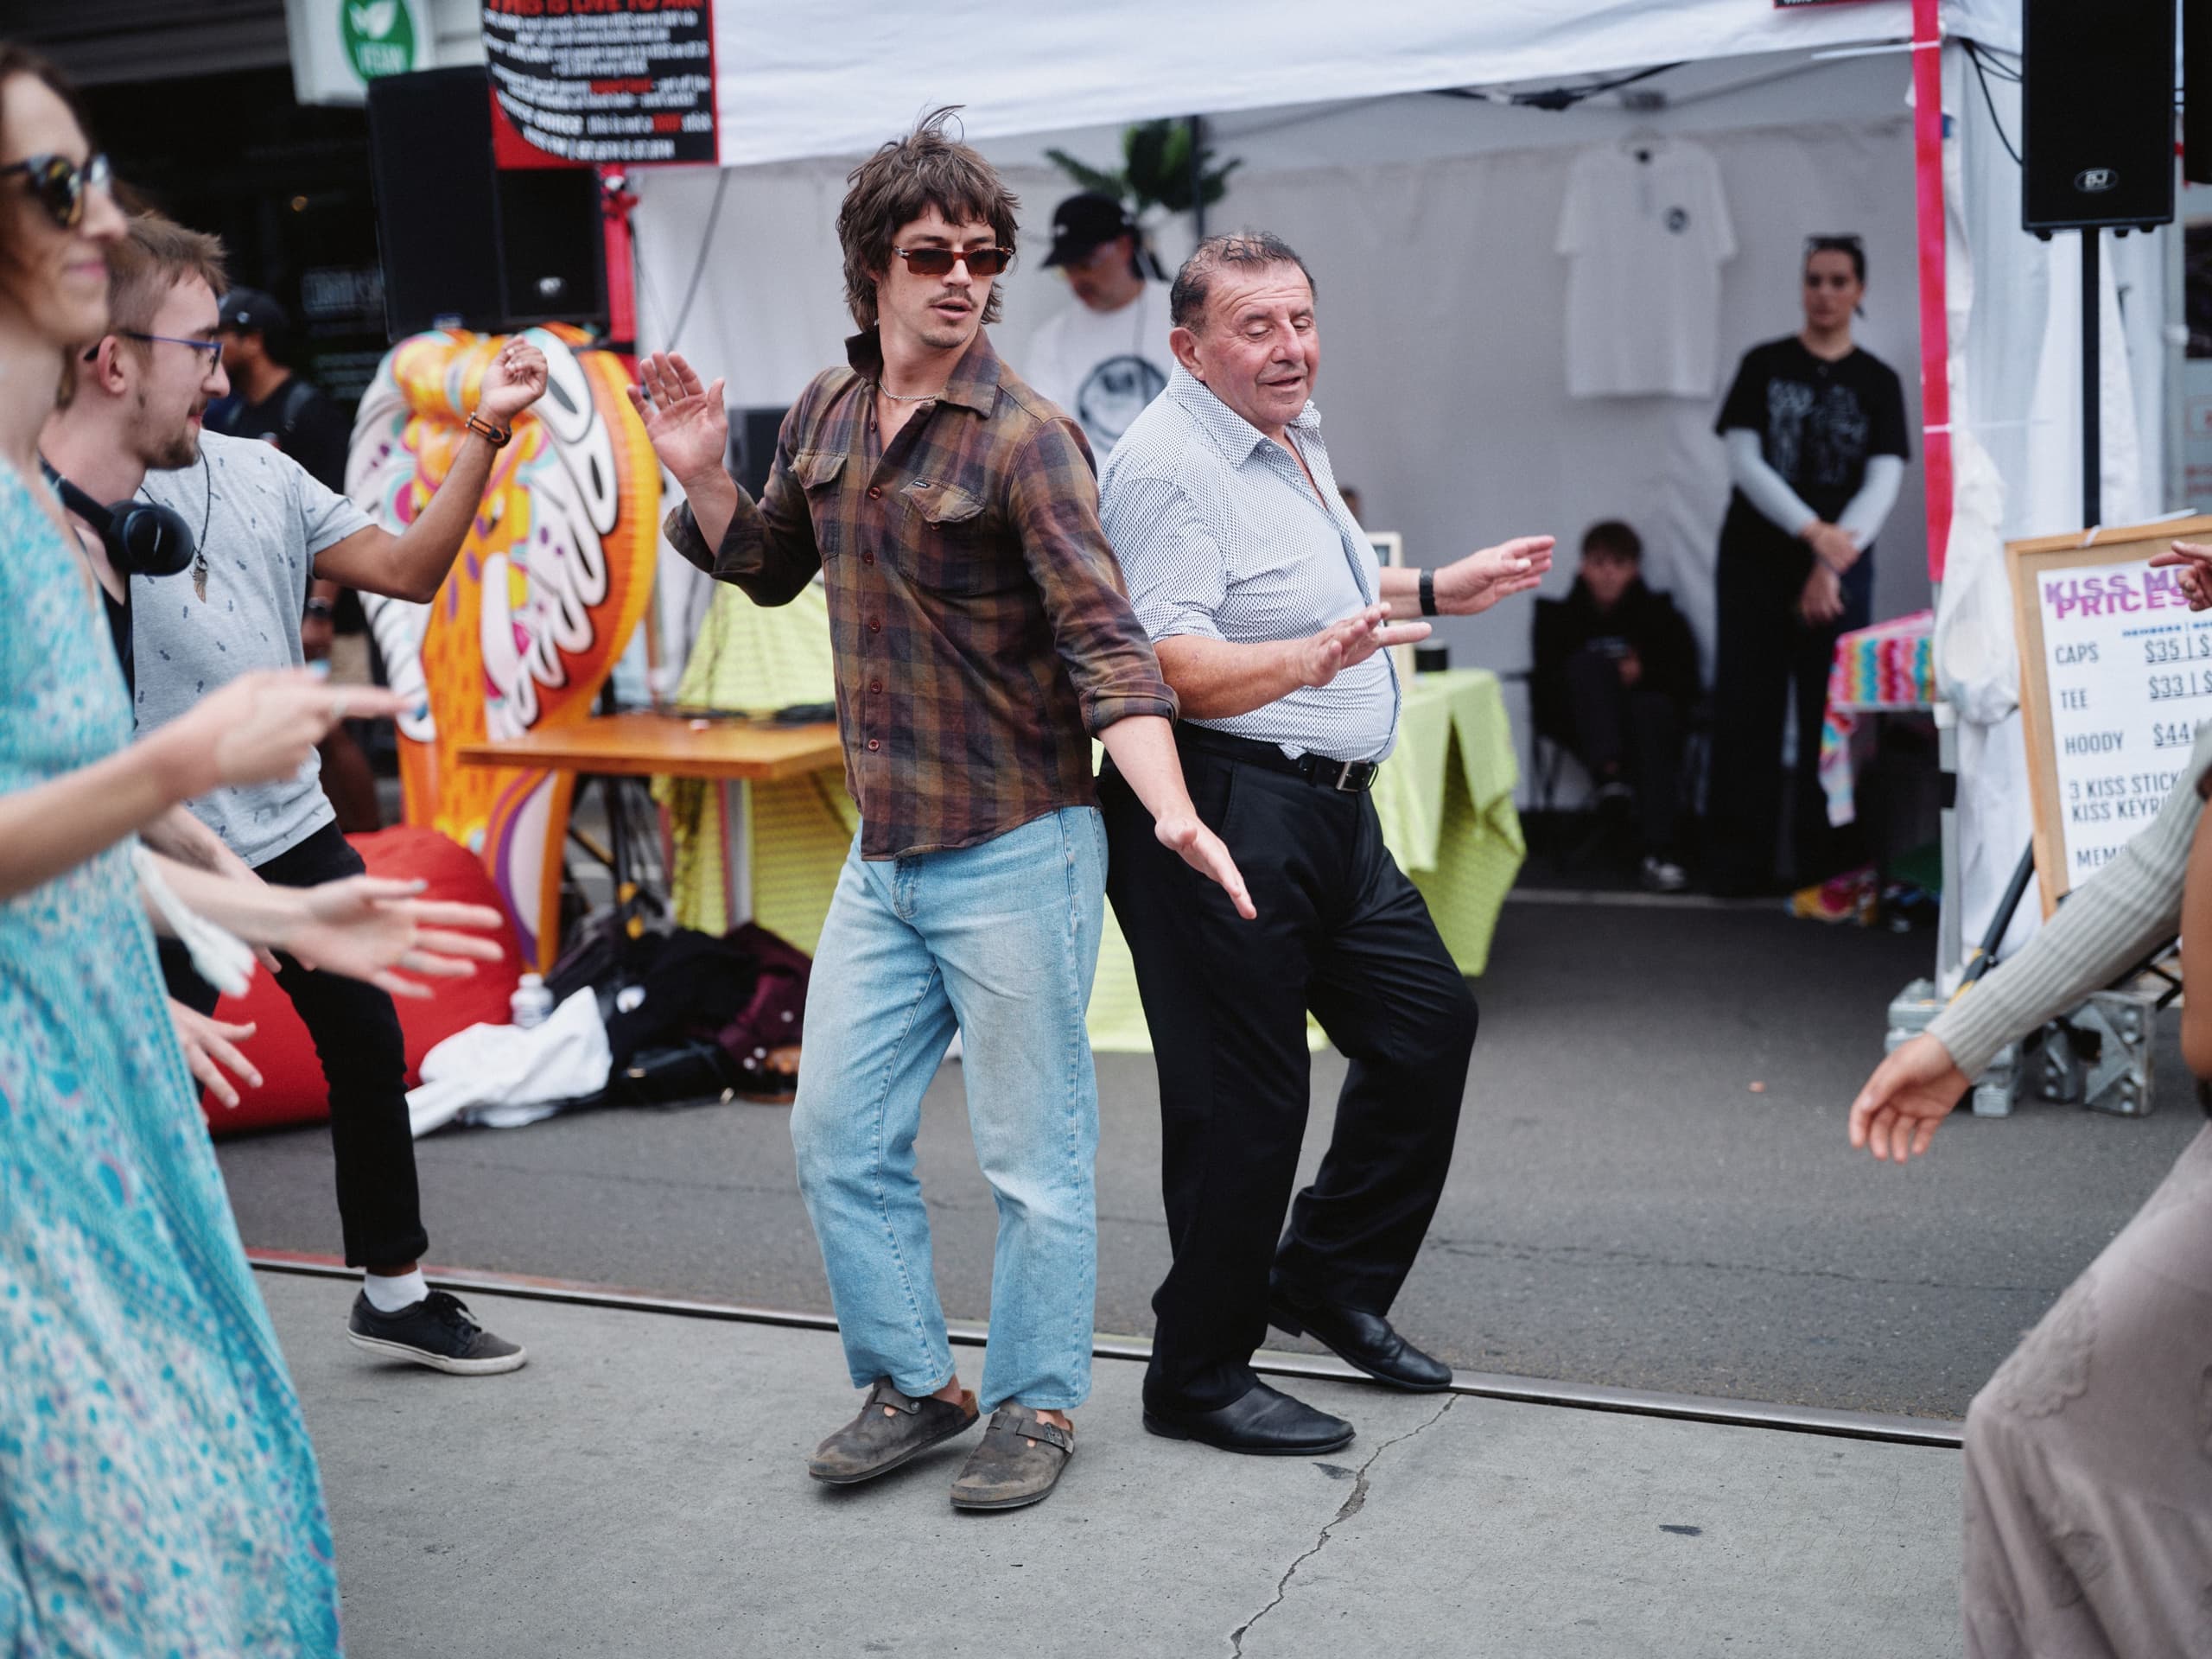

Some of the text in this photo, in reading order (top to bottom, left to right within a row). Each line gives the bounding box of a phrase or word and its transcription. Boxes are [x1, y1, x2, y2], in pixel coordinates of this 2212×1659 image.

[2046, 575, 2130, 603] KISS
[2056, 586, 2193, 619] PRICES
[2056, 643, 2099, 664] CAPS
[2145, 639, 2179, 663] $35
[2060, 689, 2088, 709] TEE
[2149, 675, 2183, 699] $33
[2065, 722, 2190, 754] HOODY $44
[2070, 781, 2080, 799] 3
[2087, 776, 2126, 797] KISS
[2073, 804, 2110, 822] KISS
